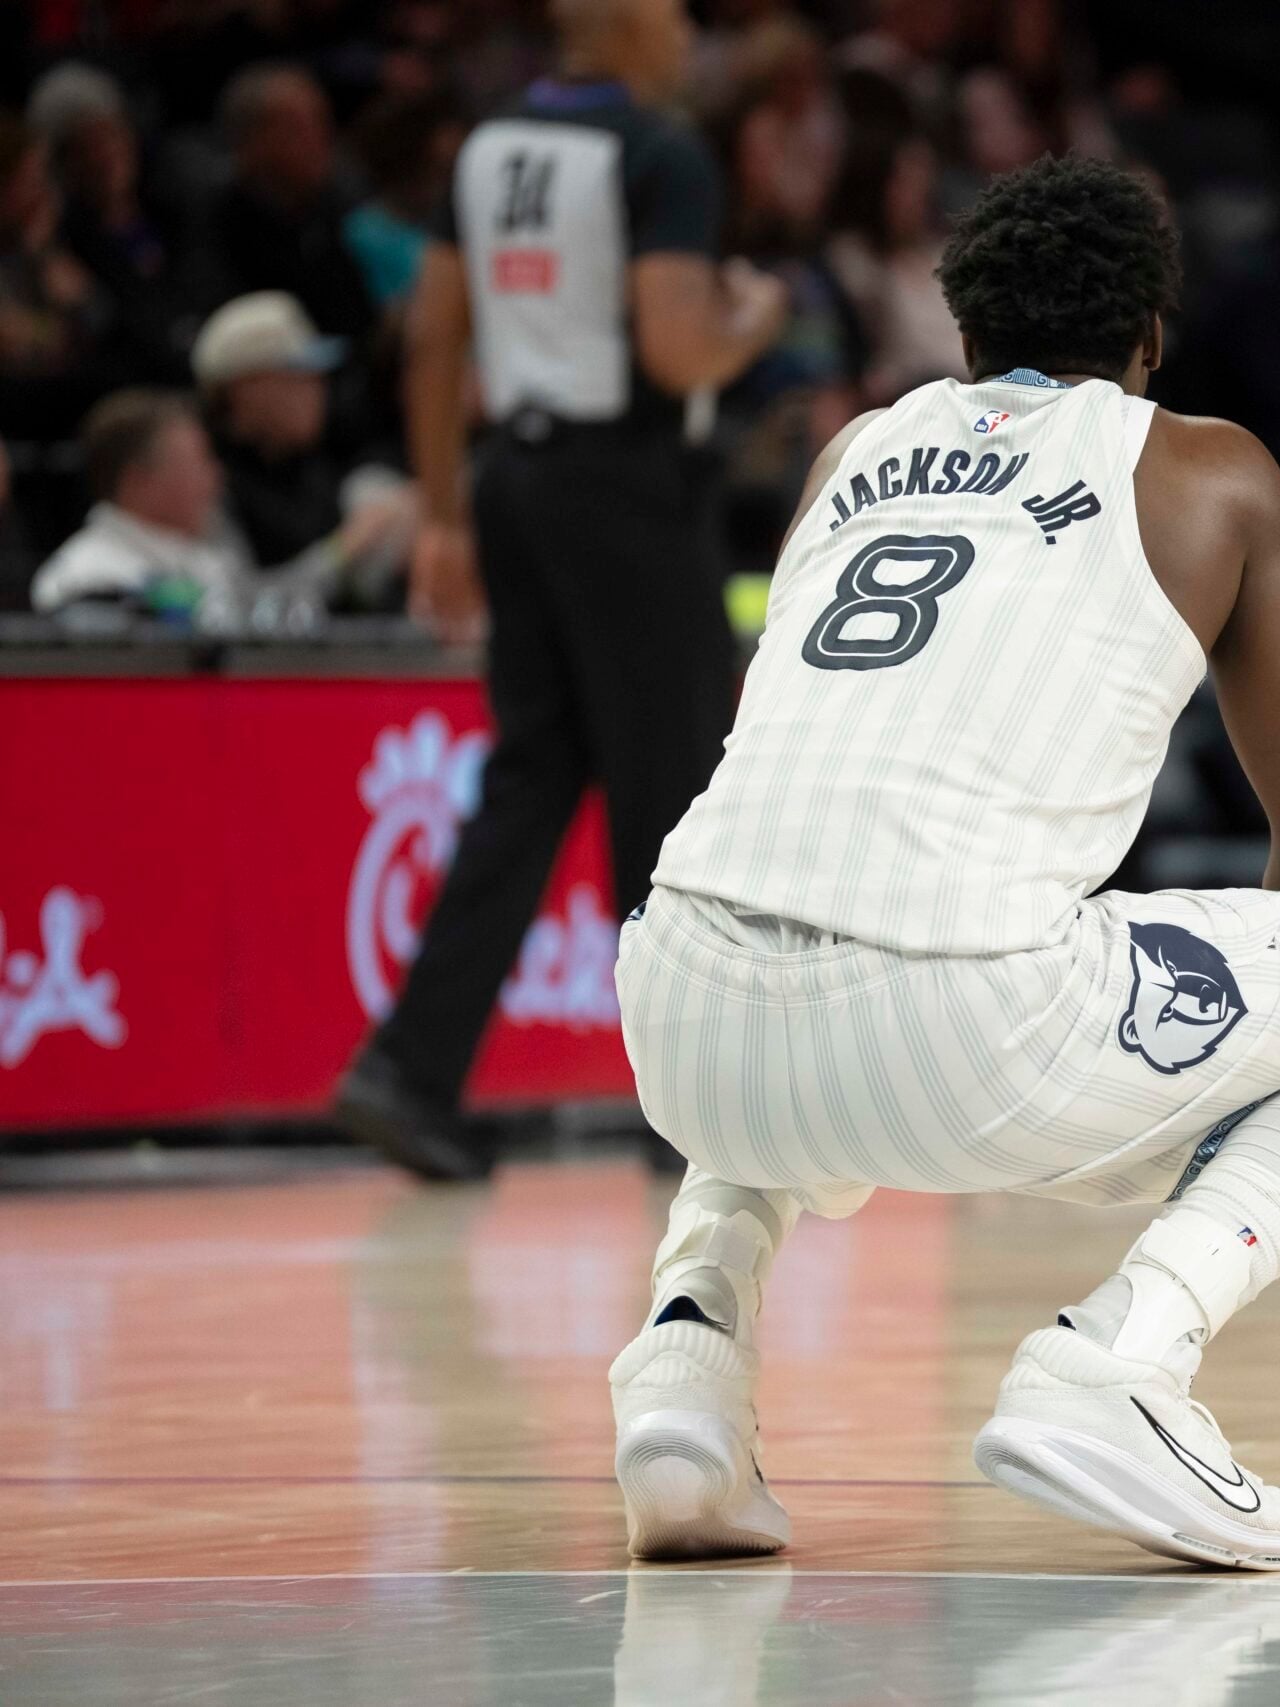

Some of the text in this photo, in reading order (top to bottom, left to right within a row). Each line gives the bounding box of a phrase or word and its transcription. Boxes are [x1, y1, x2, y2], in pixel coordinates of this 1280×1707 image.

[829, 446, 1102, 546] JACKSON JR.
[801, 534, 976, 672] 8
